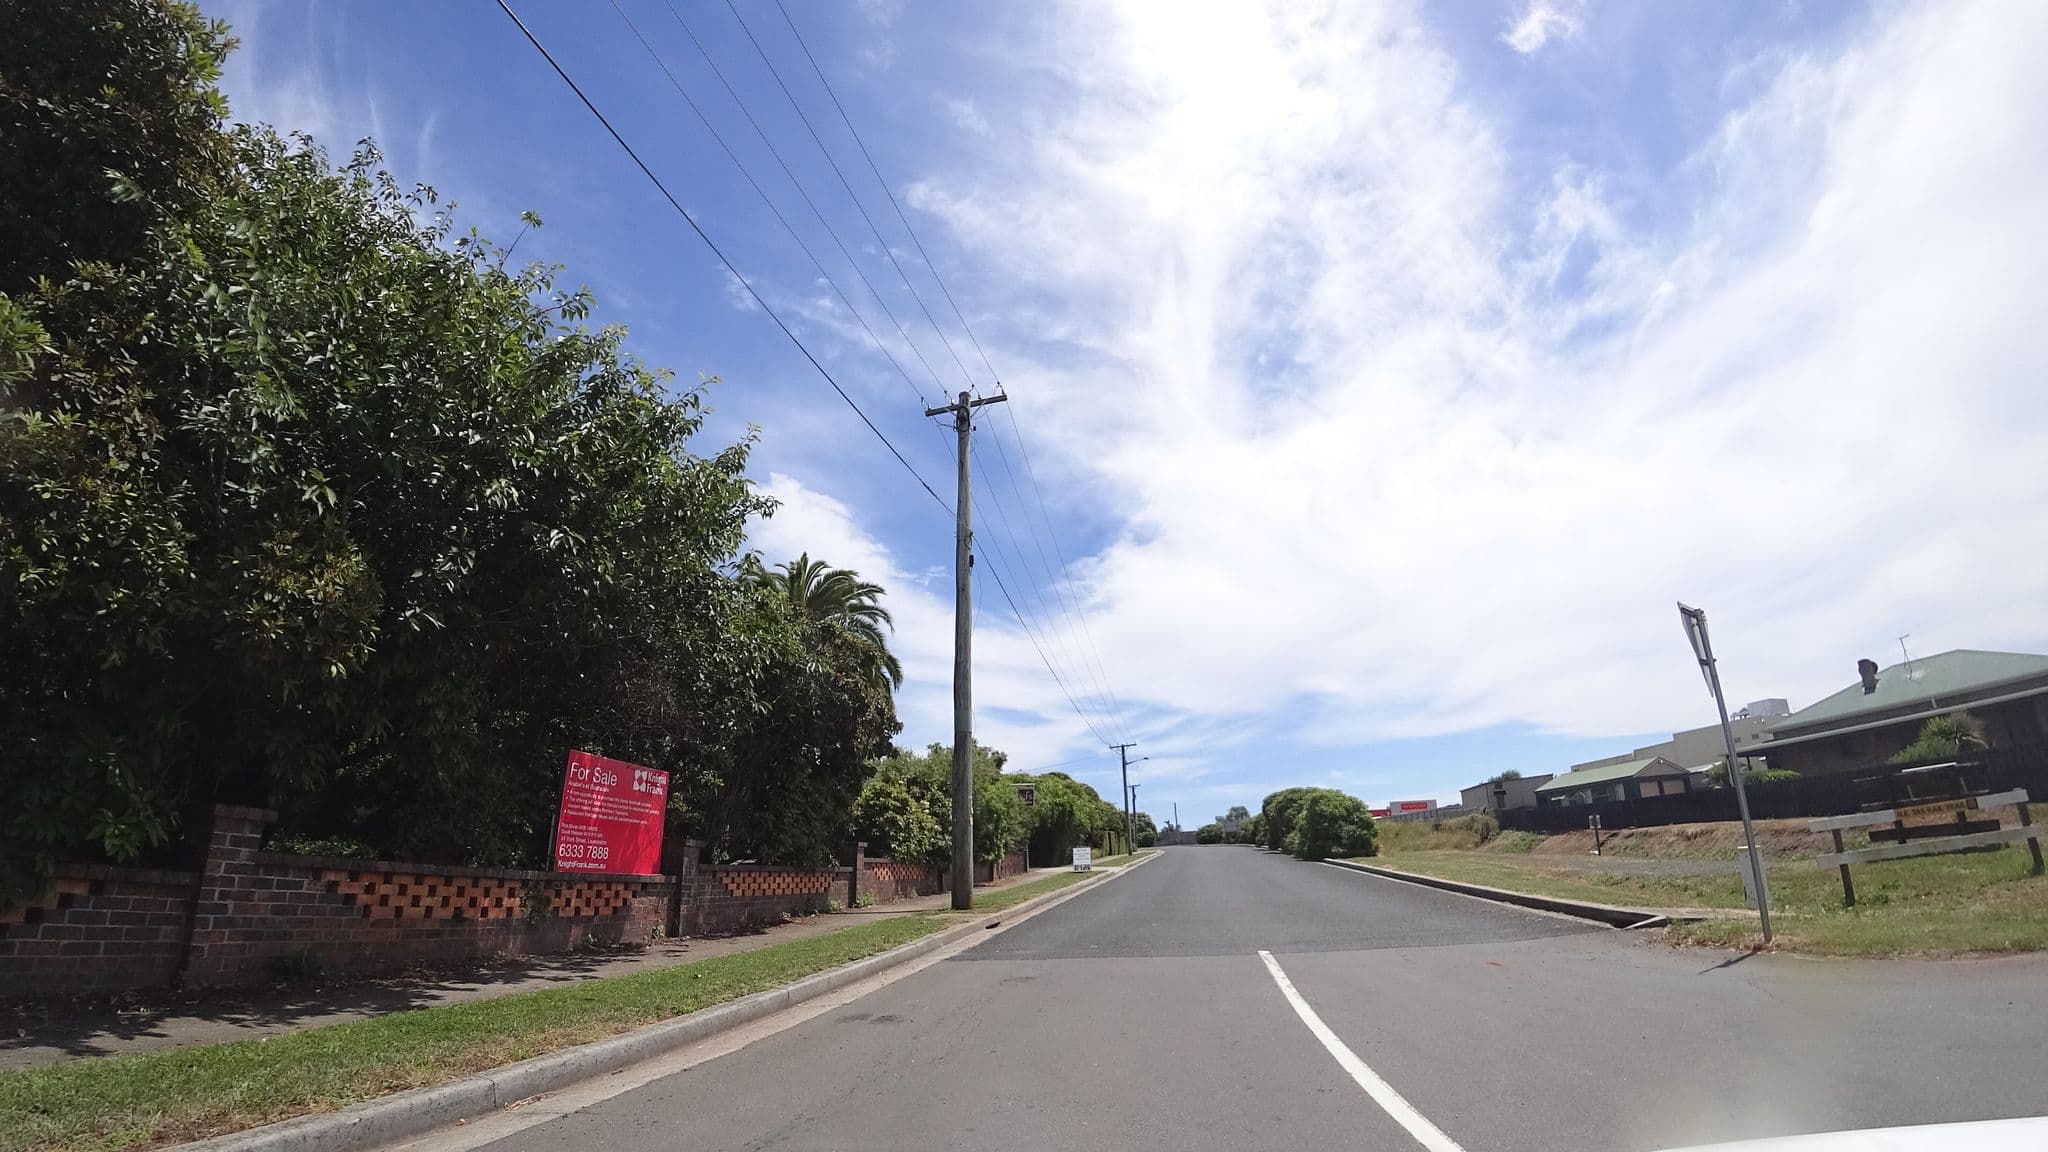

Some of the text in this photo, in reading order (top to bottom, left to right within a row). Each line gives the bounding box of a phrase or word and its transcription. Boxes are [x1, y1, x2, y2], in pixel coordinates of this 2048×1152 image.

[570, 762, 617, 786] For Sale
[648, 771, 667, 785] Knight
[647, 783, 663, 796] Frank
[559, 843, 609, 860] 6333 7888
